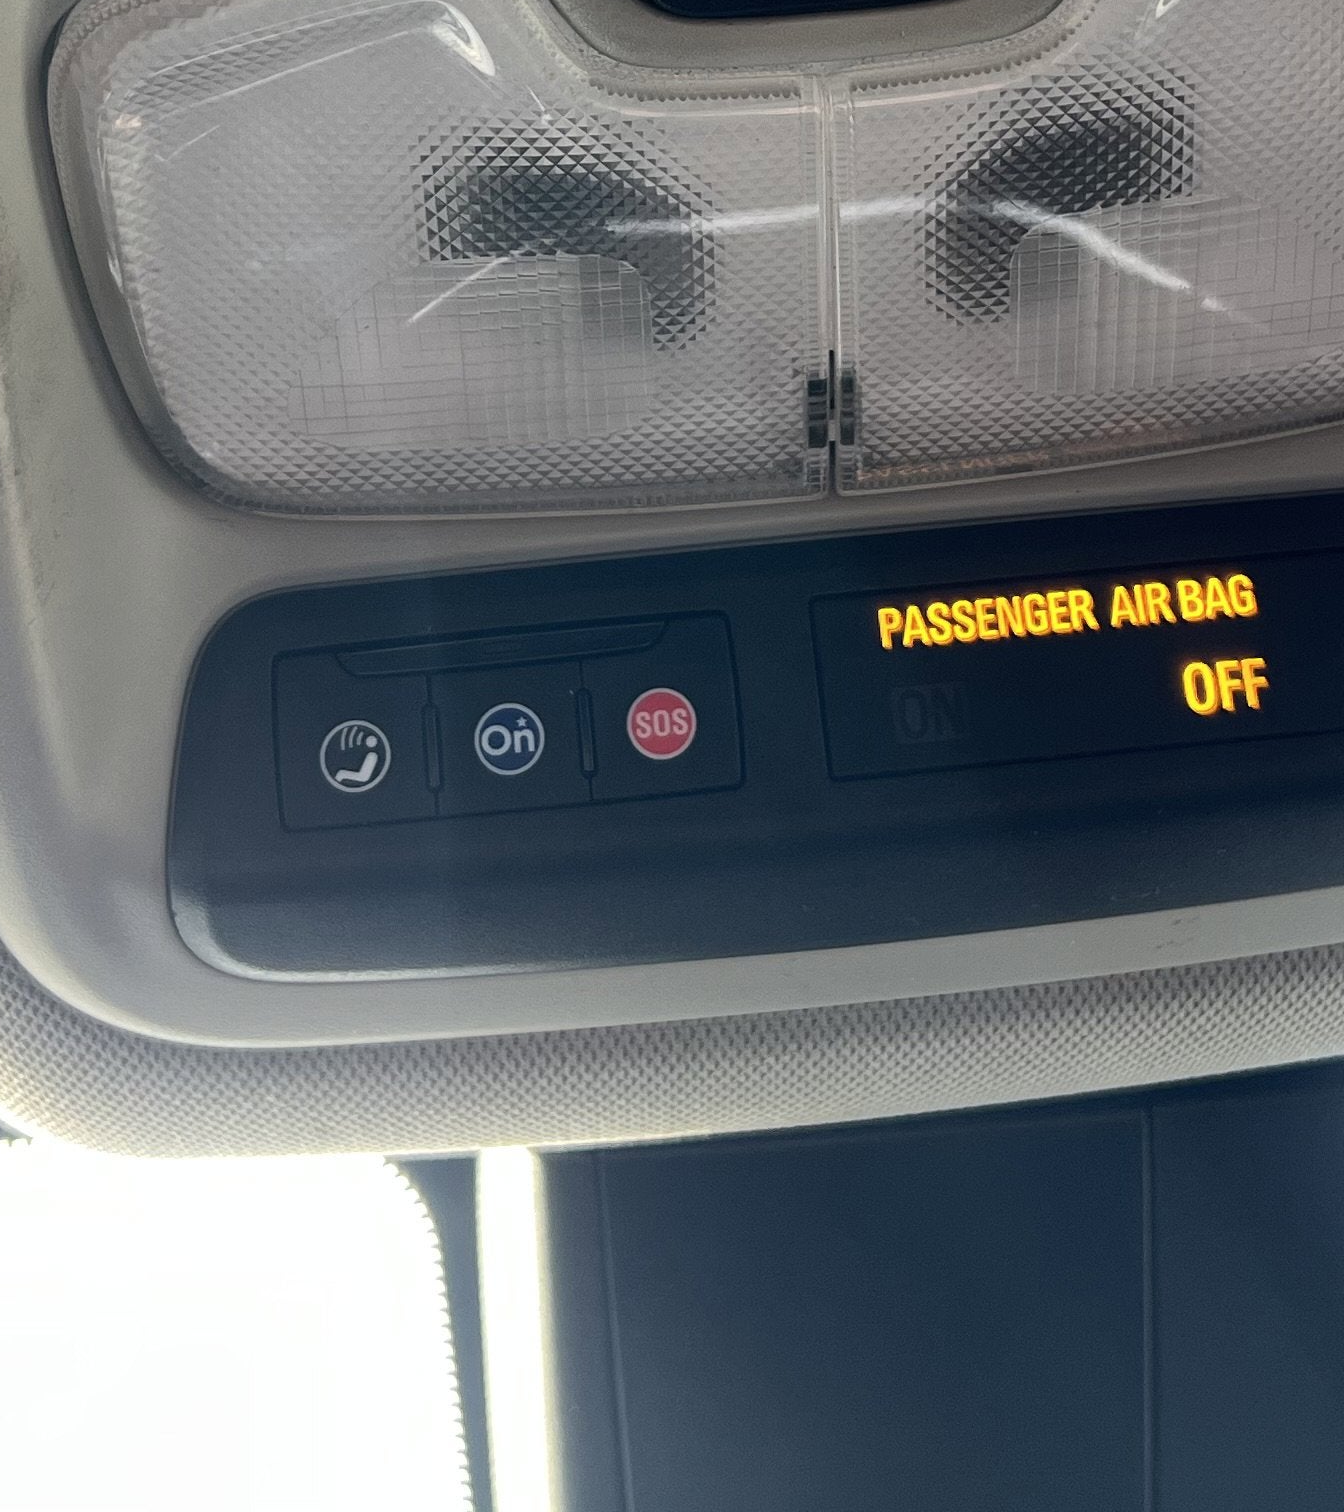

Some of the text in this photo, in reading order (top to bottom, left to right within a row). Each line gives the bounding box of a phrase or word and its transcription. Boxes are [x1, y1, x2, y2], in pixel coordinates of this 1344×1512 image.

[877, 588, 1100, 650] PASSENGER
[1182, 657, 1269, 716] OFF
[481, 723, 536, 756] On
[635, 707, 690, 739] SOS
